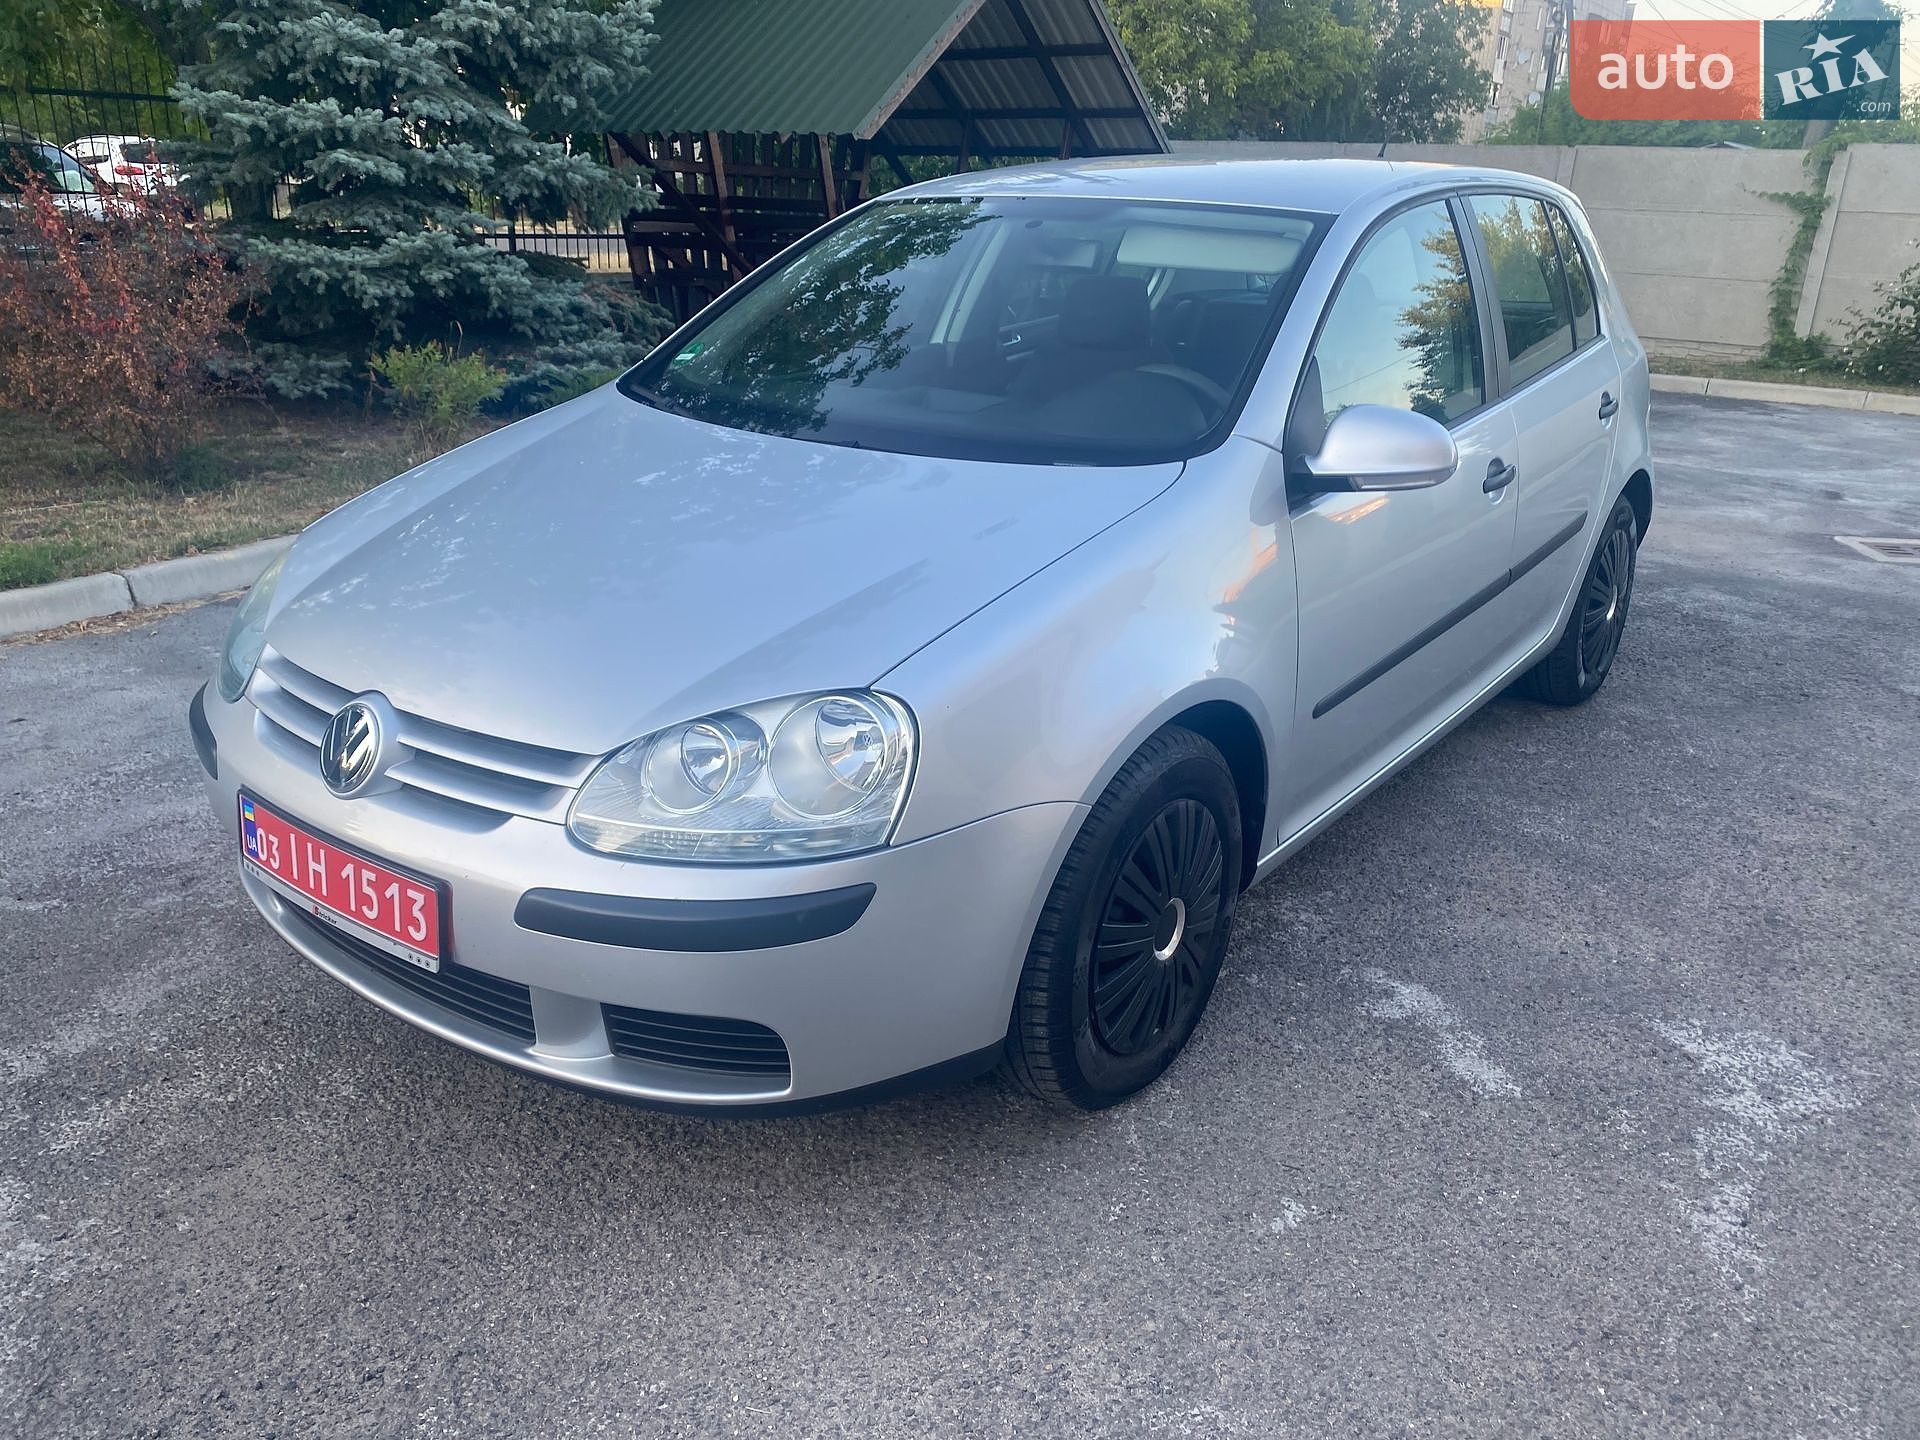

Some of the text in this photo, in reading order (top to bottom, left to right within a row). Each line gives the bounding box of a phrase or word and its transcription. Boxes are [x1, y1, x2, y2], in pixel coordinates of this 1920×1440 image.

[246, 833, 258, 852] UA
[256, 827, 280, 870] 03
[340, 863, 427, 942] 1513
